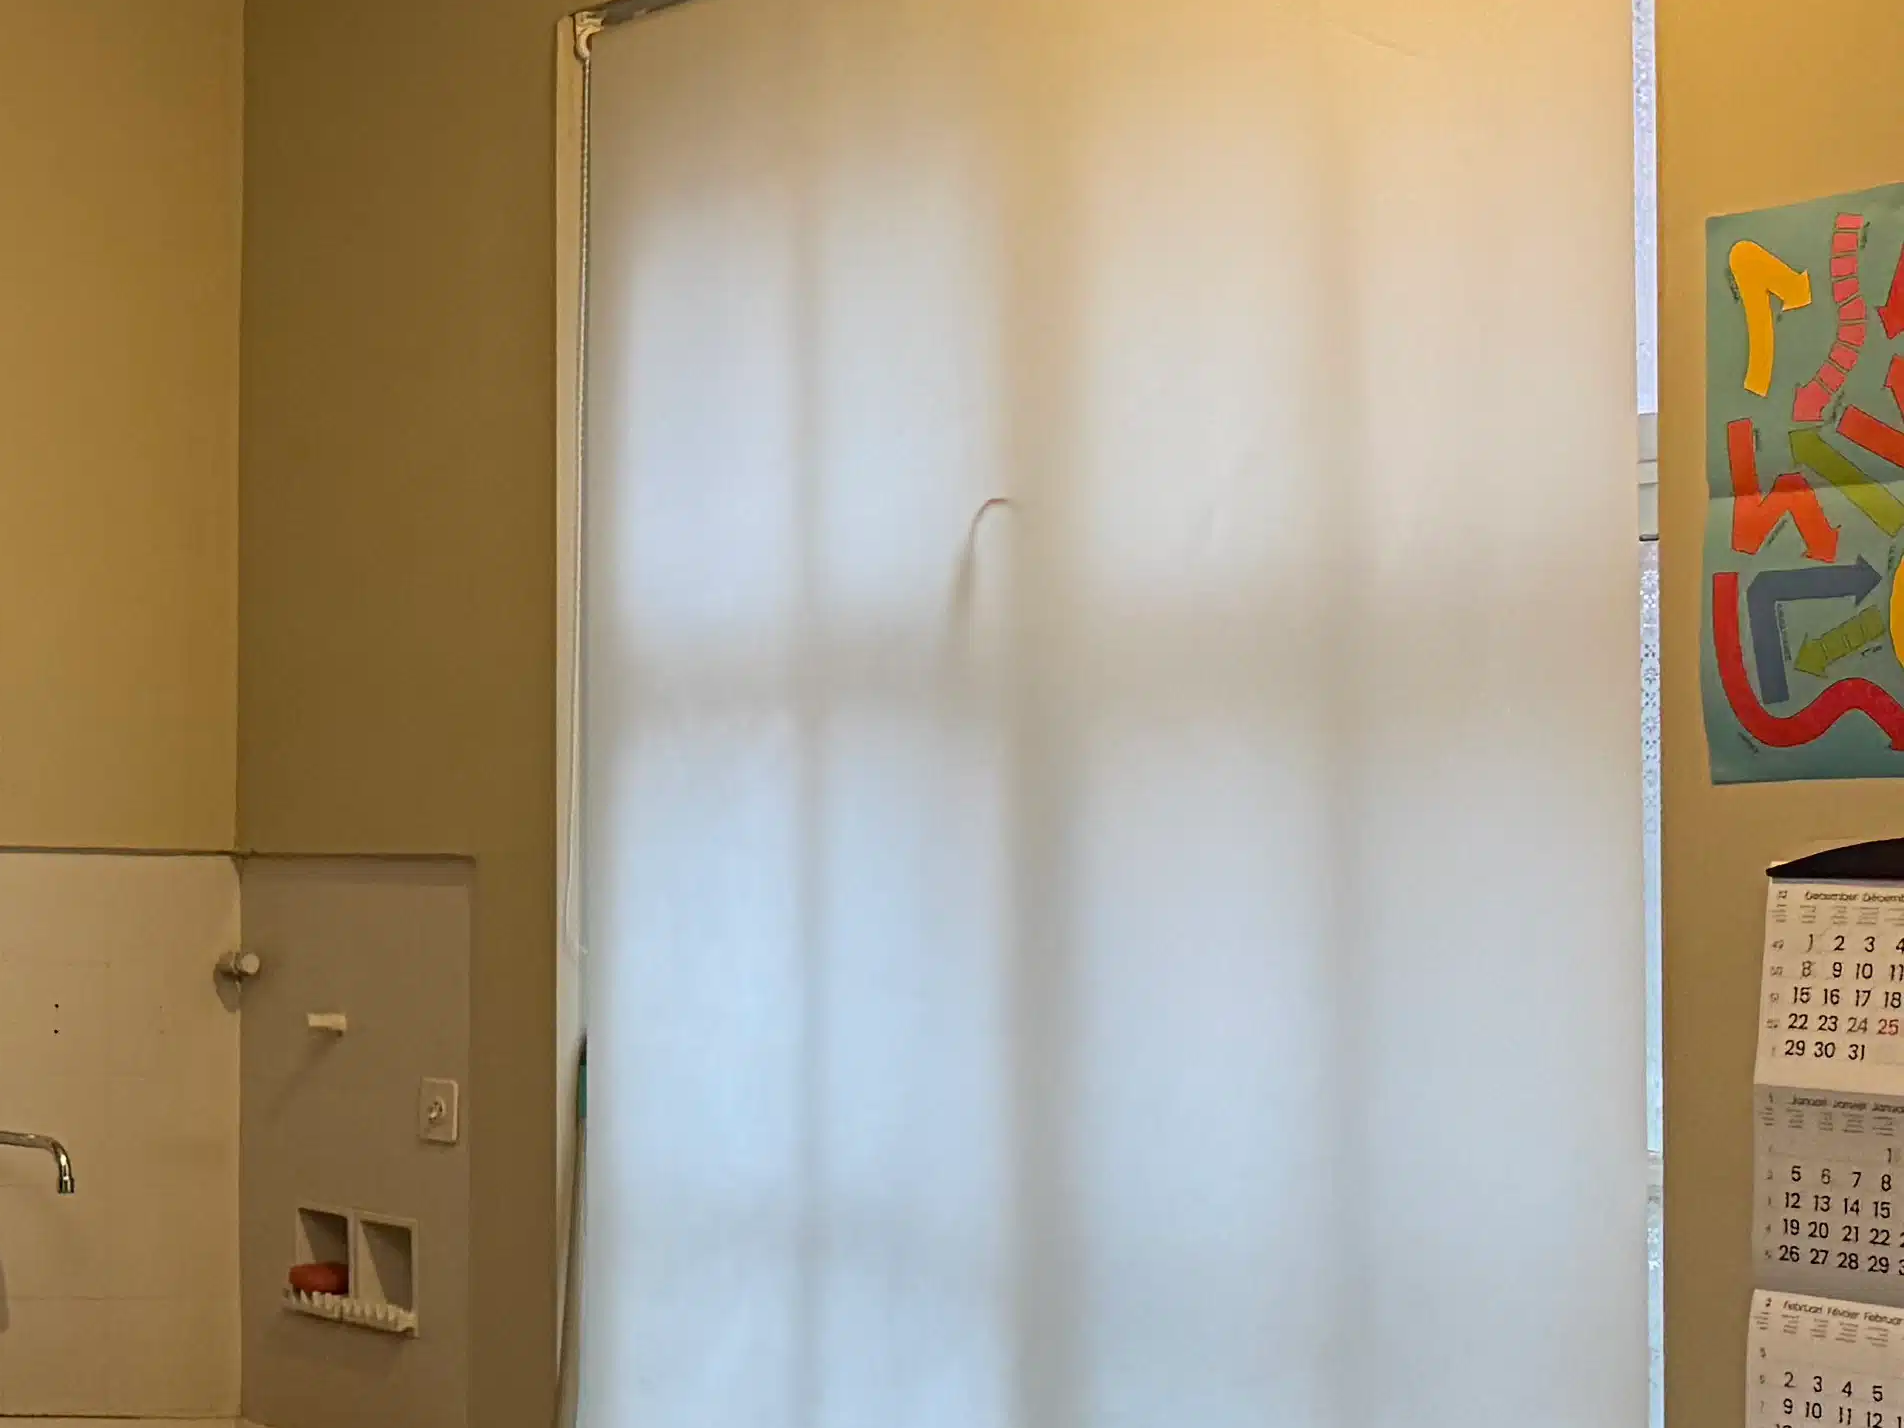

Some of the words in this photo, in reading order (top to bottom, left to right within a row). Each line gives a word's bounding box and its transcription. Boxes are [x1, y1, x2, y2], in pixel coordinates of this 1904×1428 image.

[1807, 933, 1814, 952] 1
[1833, 935, 1846, 952] 2
[1864, 936, 1876, 952] 3
[1802, 960, 1812, 977] 8
[1832, 962, 1843, 978] 9
[1855, 963, 1873, 980] 10
[1890, 964, 1904, 981] 11
[1793, 986, 1811, 1004] 15
[1823, 988, 1840, 1005] 16
[1855, 989, 1872, 1007] 17
[1884, 991, 1901, 1008] 18
[1788, 1013, 1808, 1030] 22
[1817, 1015, 1838, 1032] 23
[1847, 1017, 1868, 1033] 24
[1877, 1019, 1899, 1036] 25
[1785, 1040, 1805, 1056] 29
[1814, 1041, 1836, 1058] 30
[1848, 1044, 1865, 1061] 31
[1887, 1148, 1892, 1164] 1
[1791, 1165, 1801, 1182] 5
[1821, 1168, 1831, 1185] 6
[1852, 1172, 1862, 1188] 7
[1881, 1174, 1892, 1191] 8
[1785, 1192, 1800, 1209] 12
[1814, 1195, 1831, 1212] 13
[1844, 1198, 1860, 1215] 14
[1873, 1201, 1891, 1218] 15
[1783, 1218, 1799, 1235] 19
[1808, 1221, 1829, 1238] 20
[1842, 1225, 1859, 1243] 21
[1869, 1228, 1890, 1246] 22
[1779, 1245, 1800, 1262] 26
[1810, 1248, 1829, 1265] 27
[1837, 1252, 1858, 1270] 28
[1868, 1255, 1889, 1273] 29
[1784, 1372, 1796, 1388] 2
[1813, 1376, 1823, 1393] 3
[1842, 1381, 1852, 1398] 4
[1872, 1385, 1883, 1402] 5
[1783, 1398, 1793, 1414] 9
[1805, 1401, 1822, 1419] 10
[1839, 1406, 1852, 1425] 11
